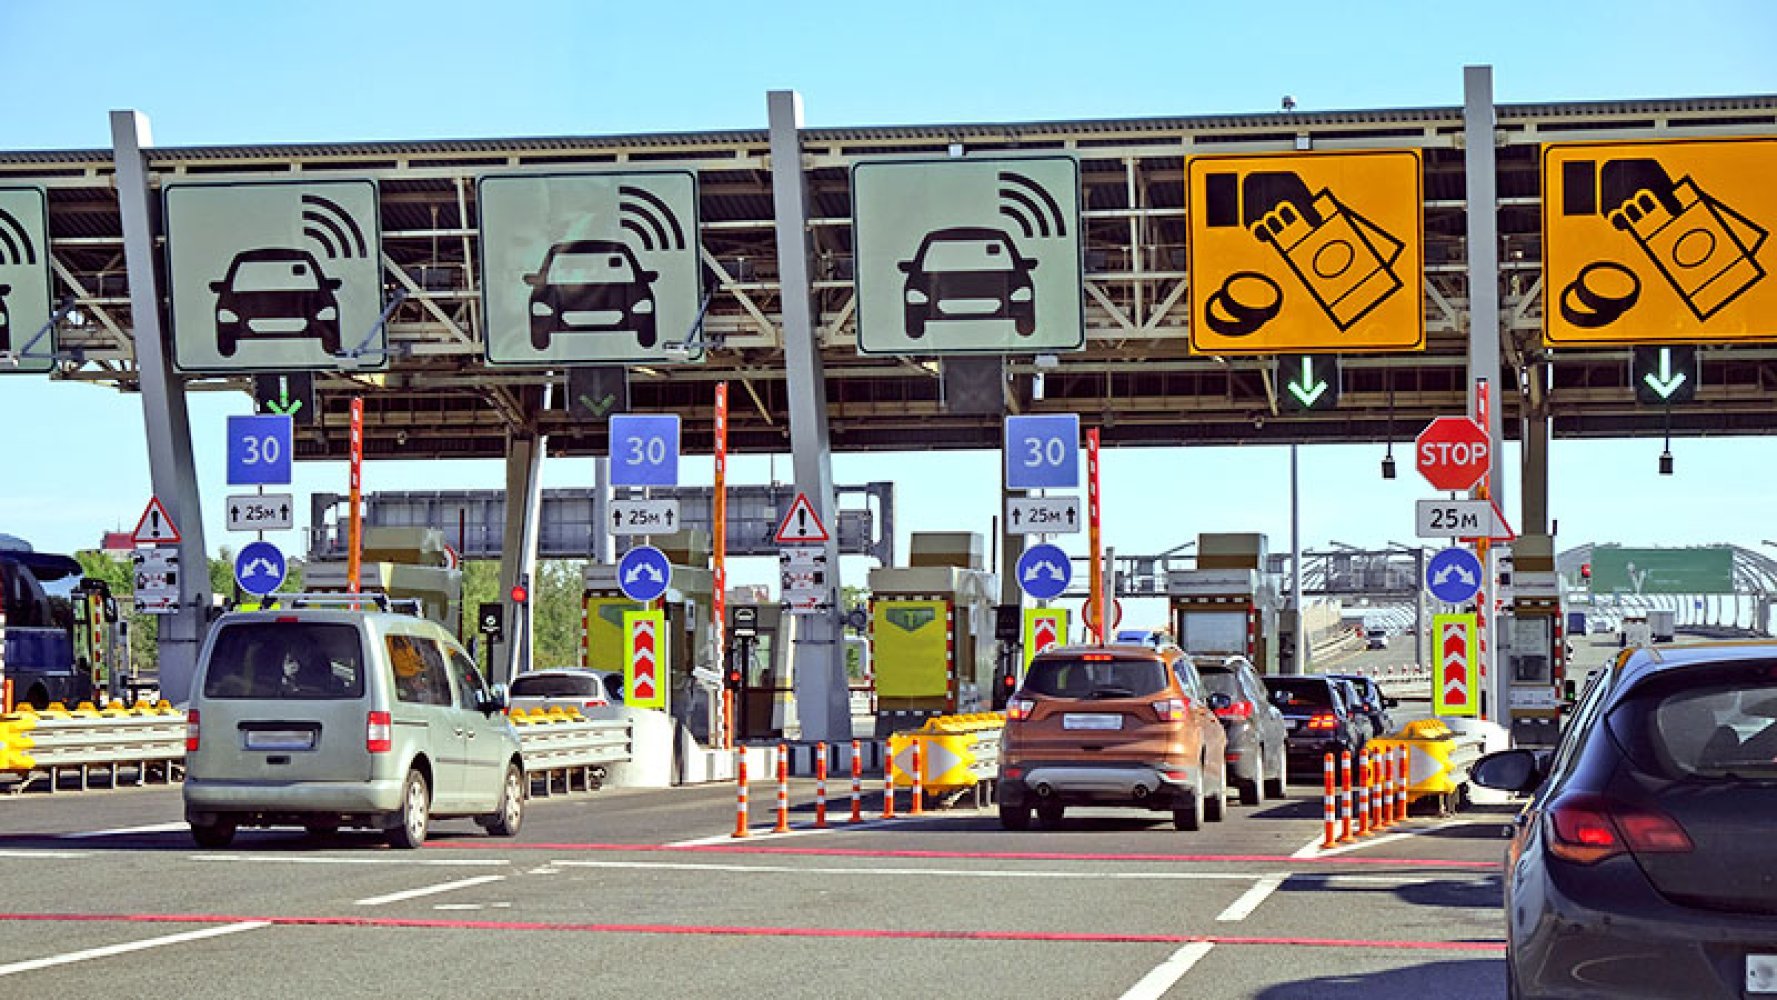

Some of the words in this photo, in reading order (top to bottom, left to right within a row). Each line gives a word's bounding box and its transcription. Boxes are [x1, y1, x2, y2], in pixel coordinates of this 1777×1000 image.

[241, 435, 280, 465] 30
[626, 436, 665, 465] 30
[1023, 437, 1065, 467] 30
[1421, 441, 1487, 466] STOP
